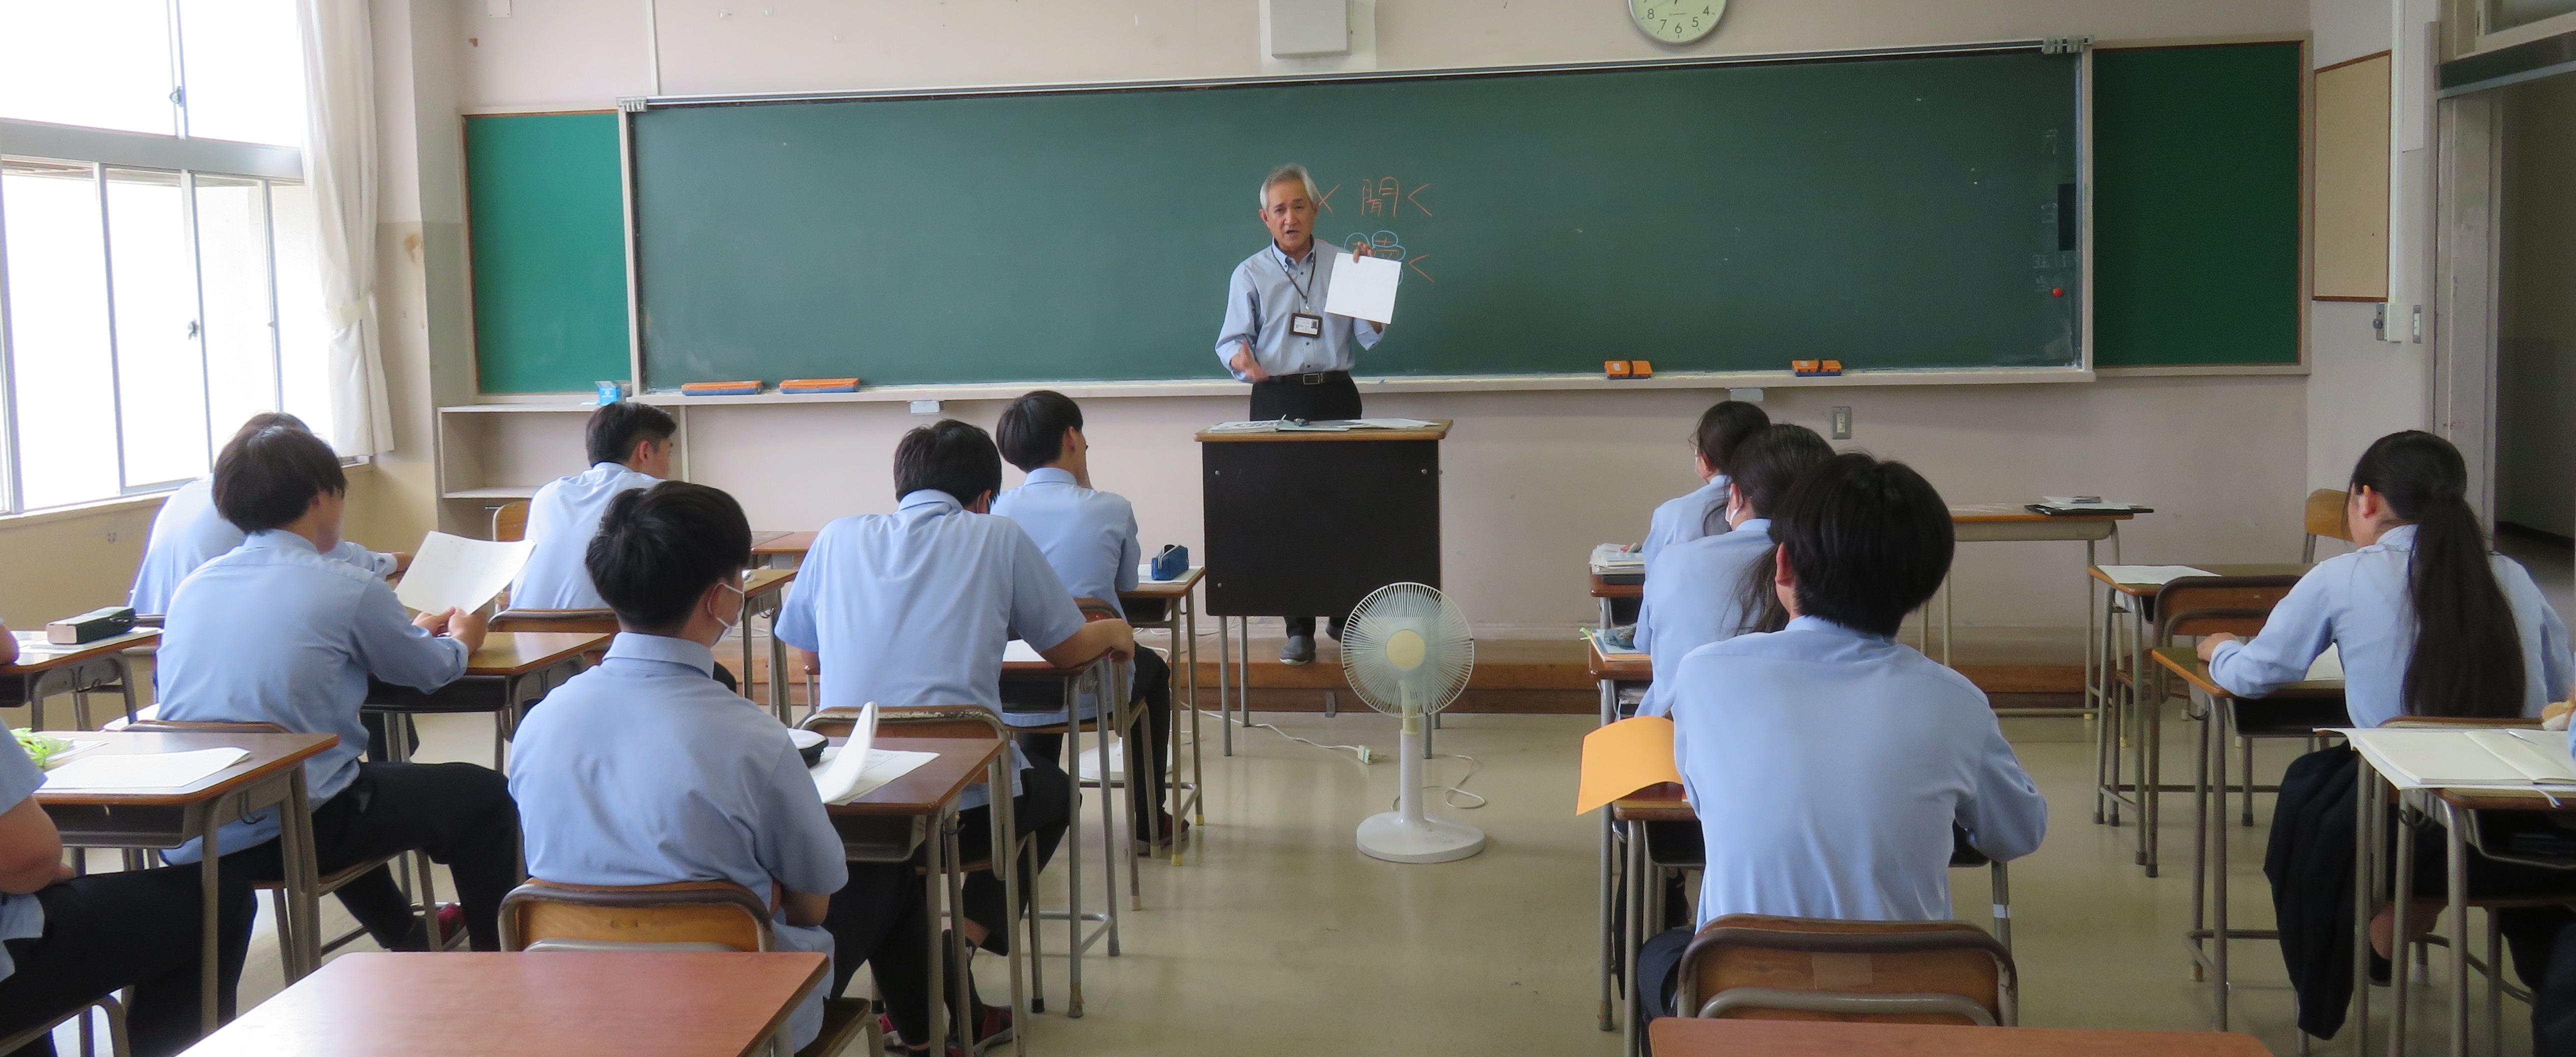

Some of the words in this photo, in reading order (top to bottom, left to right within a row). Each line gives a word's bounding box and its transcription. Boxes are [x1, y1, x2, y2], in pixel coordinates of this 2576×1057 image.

[1647, 9, 1655, 20] 8
[1703, 6, 1710, 16] 4
[1660, 20, 1667, 30] 7
[1691, 17, 1698, 28] 5
[1675, 23, 1682, 34] 6
